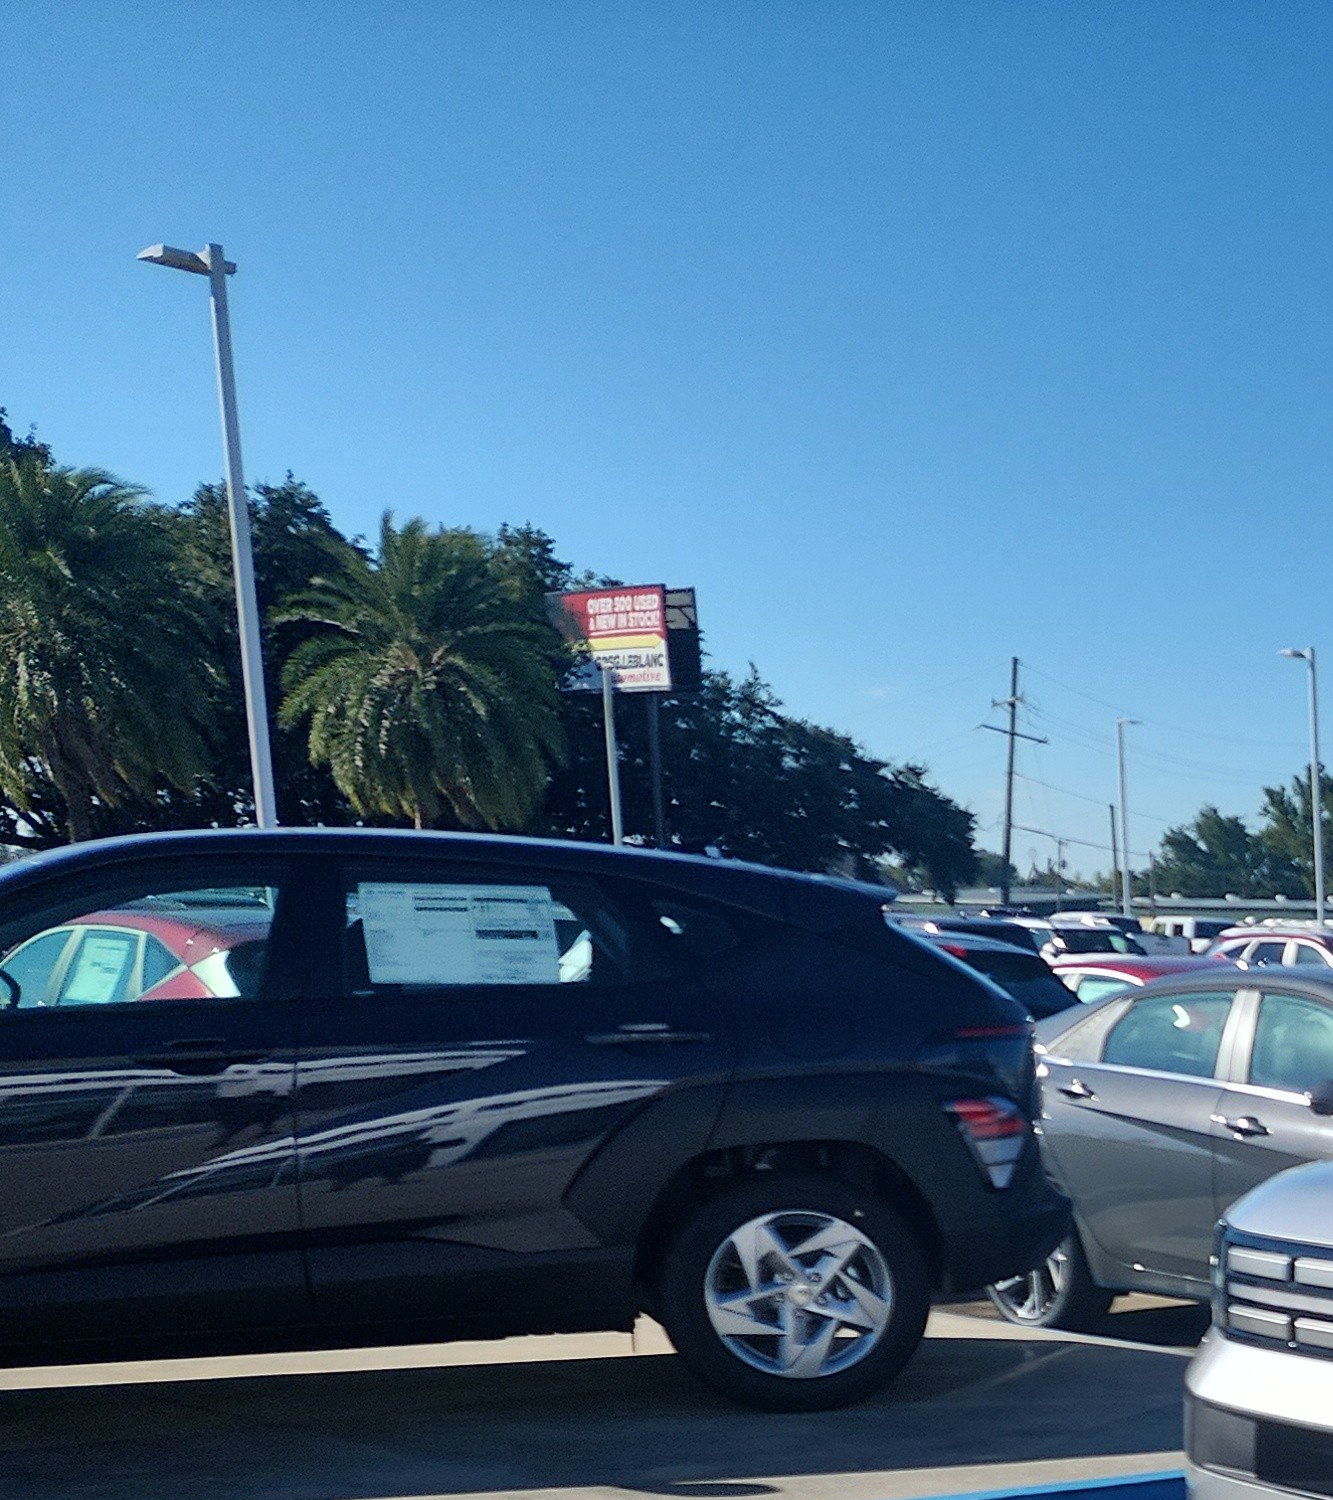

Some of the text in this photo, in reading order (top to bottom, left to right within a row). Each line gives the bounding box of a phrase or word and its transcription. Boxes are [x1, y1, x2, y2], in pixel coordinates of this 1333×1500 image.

[587, 598, 613, 614] OVER
[633, 594, 659, 611] USED
[595, 614, 617, 630] NEW
